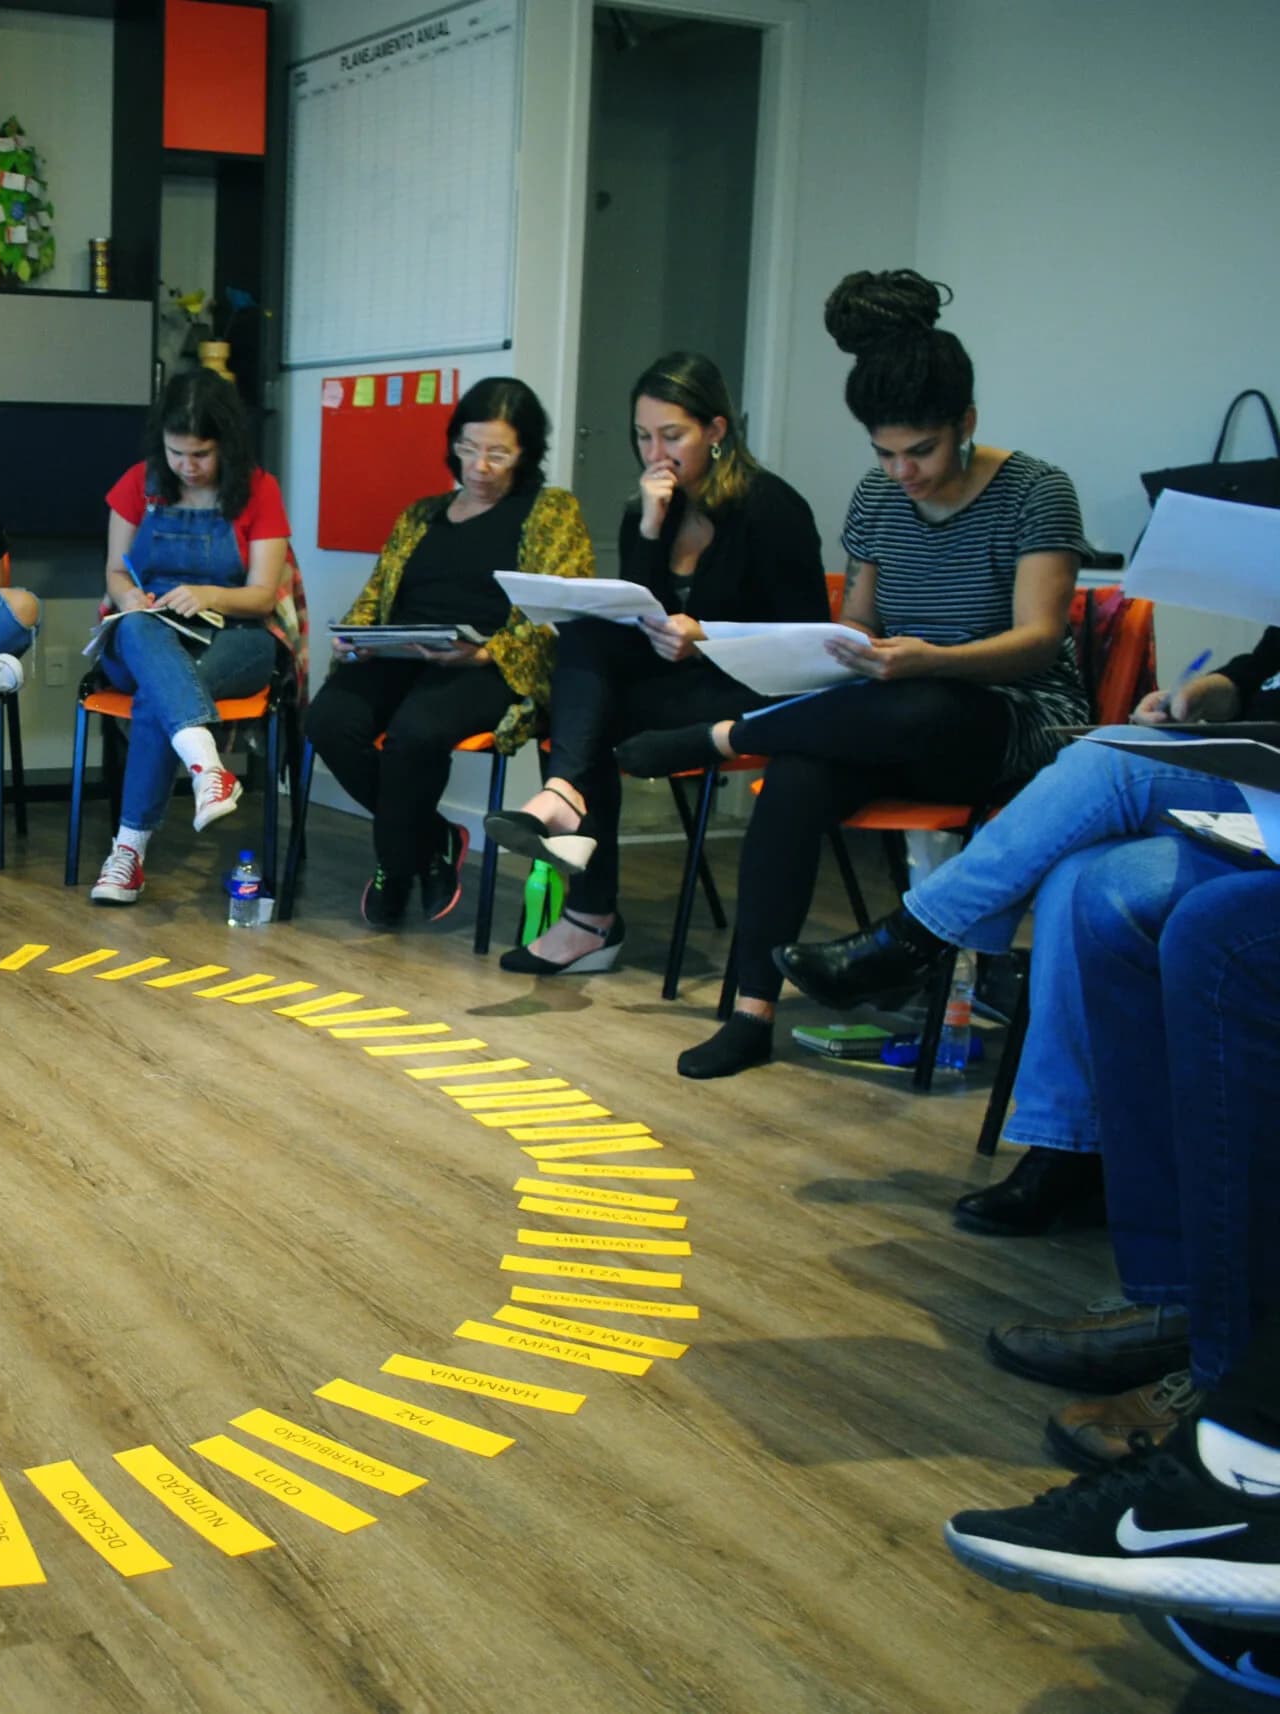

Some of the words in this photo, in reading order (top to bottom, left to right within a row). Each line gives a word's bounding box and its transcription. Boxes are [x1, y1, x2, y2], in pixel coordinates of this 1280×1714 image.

[340, 31, 415, 71] PLANEJAMENTO
[418, 19, 450, 43] ANUAL
[554, 1187, 634, 1201] CONEXÃO
[554, 1205, 648, 1223] ACEITAÇÃO
[555, 1236, 648, 1250] LIBERDADE
[557, 1265, 622, 1278] BELEZA
[541, 1294, 672, 1312] EMPODERAMENTO
[539, 1319, 593, 1336] ESTAR
[507, 1335, 592, 1361] EMPATIA
[601, 1333, 645, 1348] BEM
[430, 1368, 541, 1400] HARMONIA
[393, 1408, 435, 1427] PAZ
[273, 1426, 386, 1478] CONTRIBUIÇÃO
[255, 1468, 303, 1497] LUTO
[157, 1473, 230, 1528] NUTRIÇÃO
[61, 1489, 128, 1551] DESCANSO
